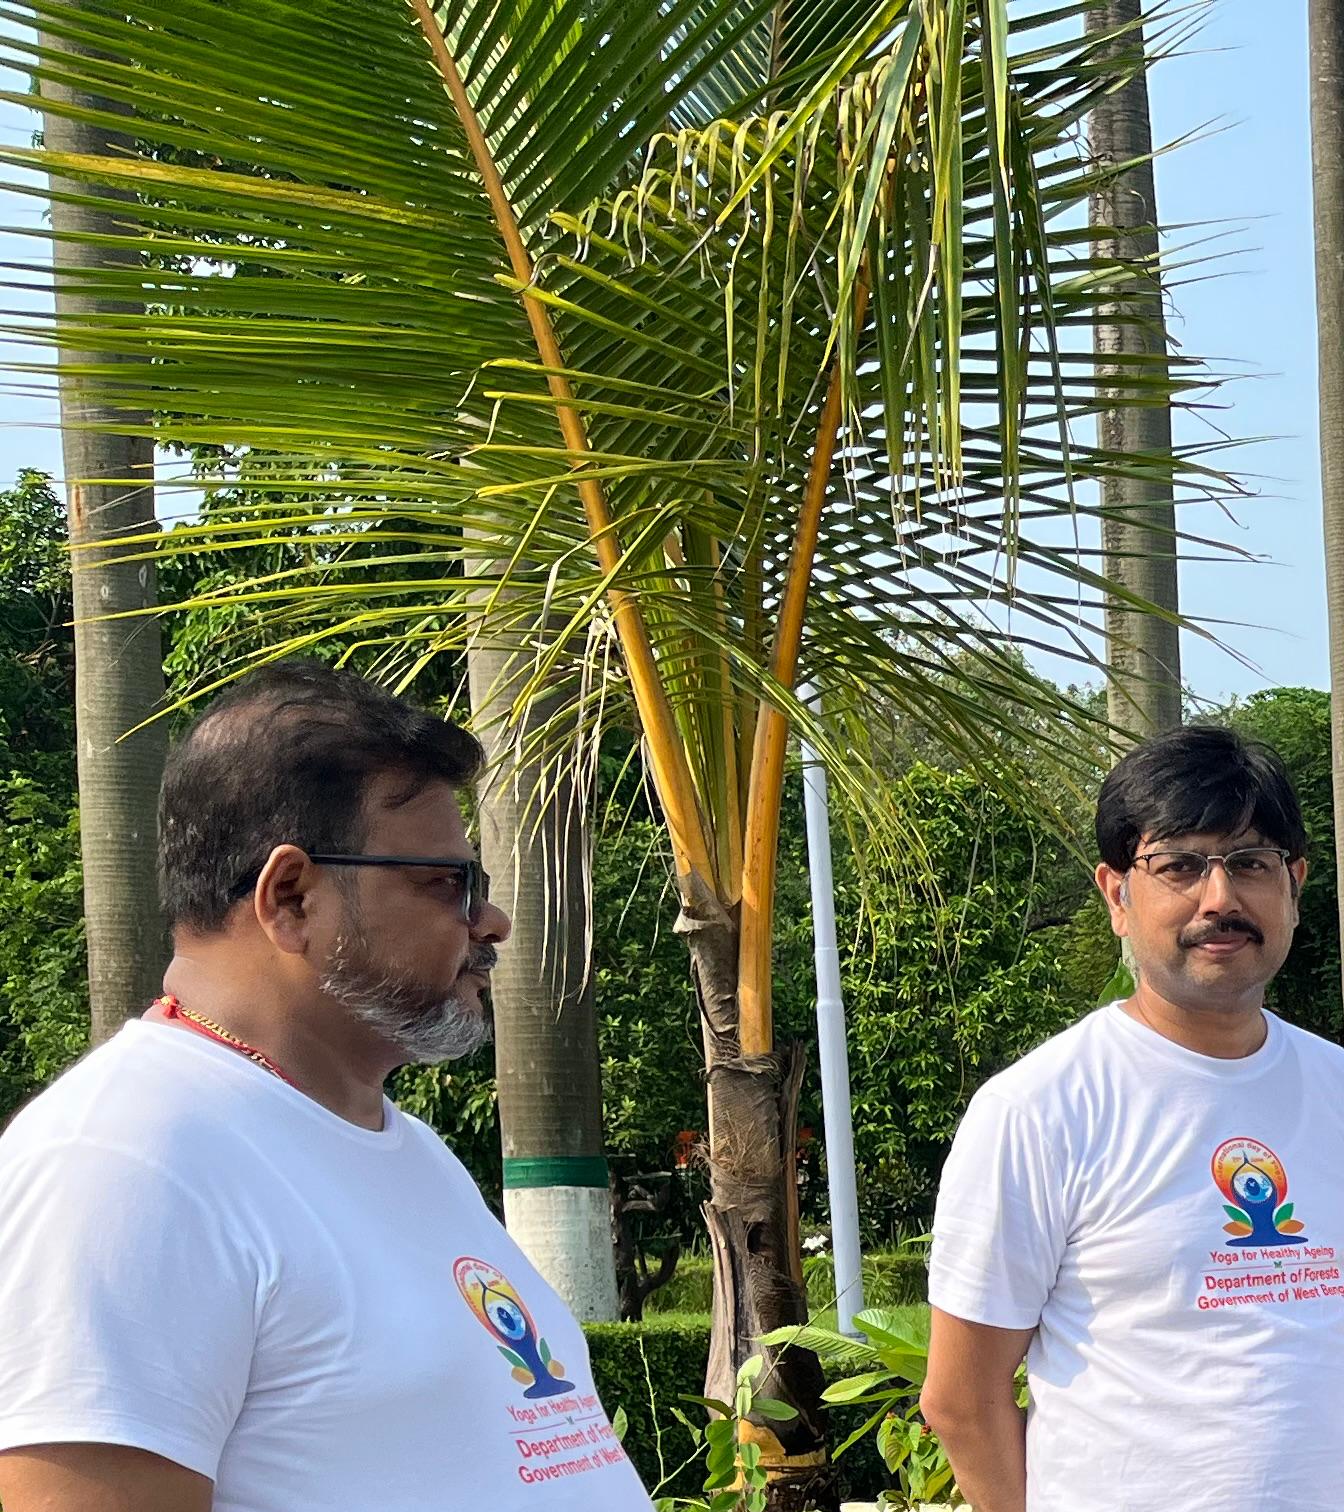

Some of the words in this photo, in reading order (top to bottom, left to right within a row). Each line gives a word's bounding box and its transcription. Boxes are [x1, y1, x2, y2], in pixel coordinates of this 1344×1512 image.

[1209, 1251, 1239, 1265] Yoga
[1242, 1250, 1257, 1261] for
[1260, 1247, 1301, 1260] Healthy
[1205, 1271, 1286, 1292] Department
[1290, 1267, 1303, 1283] of
[1303, 1266, 1340, 1281] Forests
[1197, 1291, 1276, 1310] Government
[1278, 1288, 1290, 1302] of
[1293, 1286, 1320, 1300] West
[505, 1403, 537, 1424] Yoga
[515, 1428, 588, 1459] Department
[518, 1455, 593, 1484] Government
